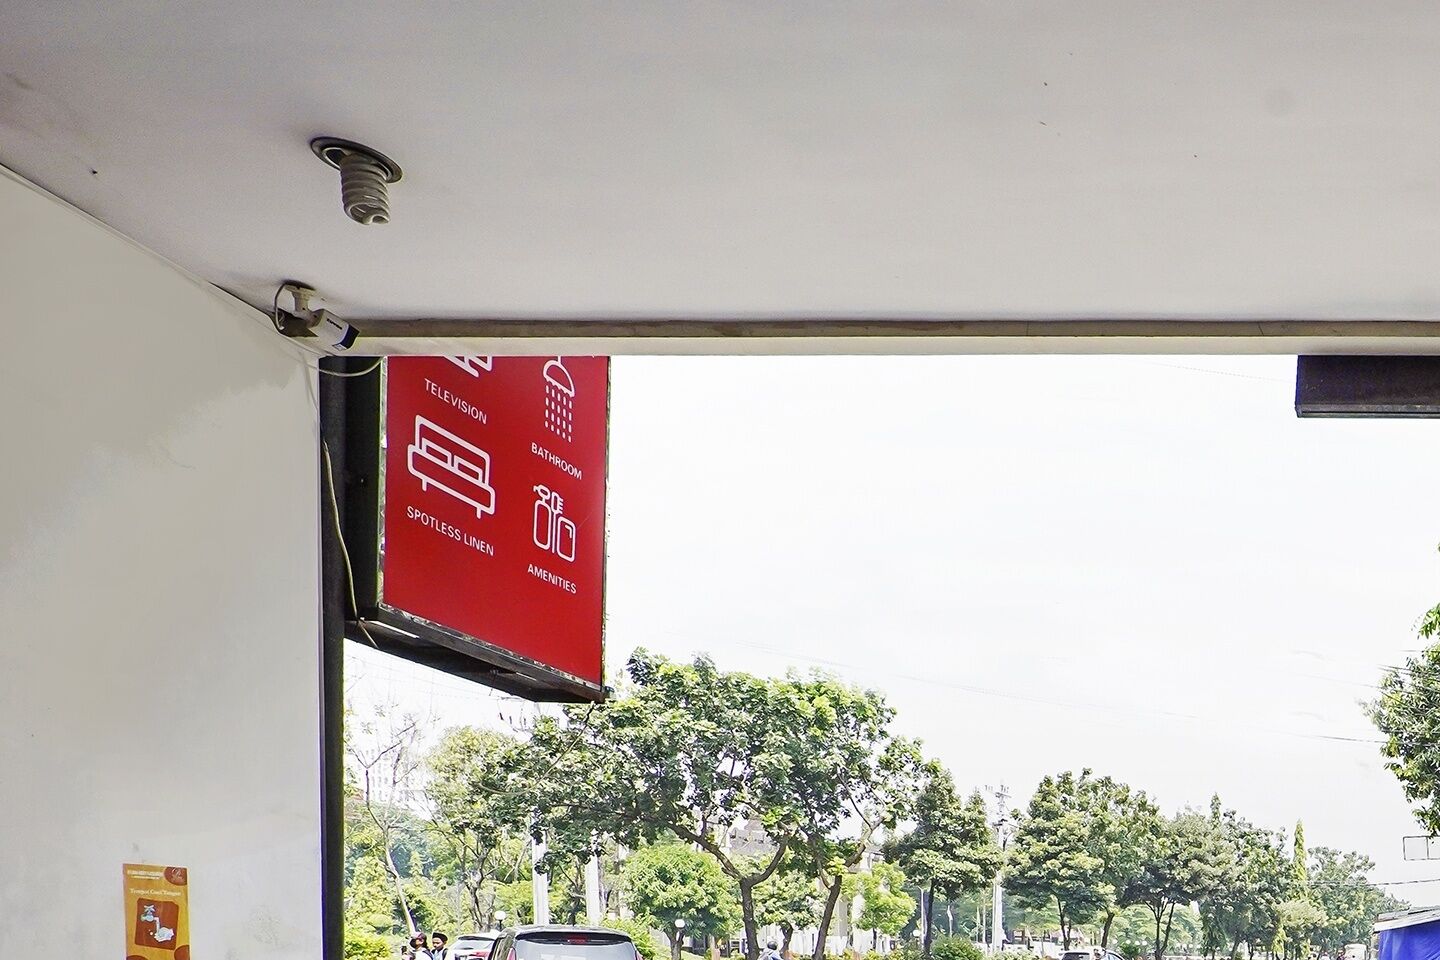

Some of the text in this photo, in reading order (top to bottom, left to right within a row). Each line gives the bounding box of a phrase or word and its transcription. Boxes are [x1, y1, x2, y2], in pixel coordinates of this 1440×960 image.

[424, 377, 488, 425] TELEVISION
[530, 442, 583, 480] BATHROOM
[406, 505, 495, 557] SPOTLESS LINEN
[526, 563, 578, 594] AMENITIES
